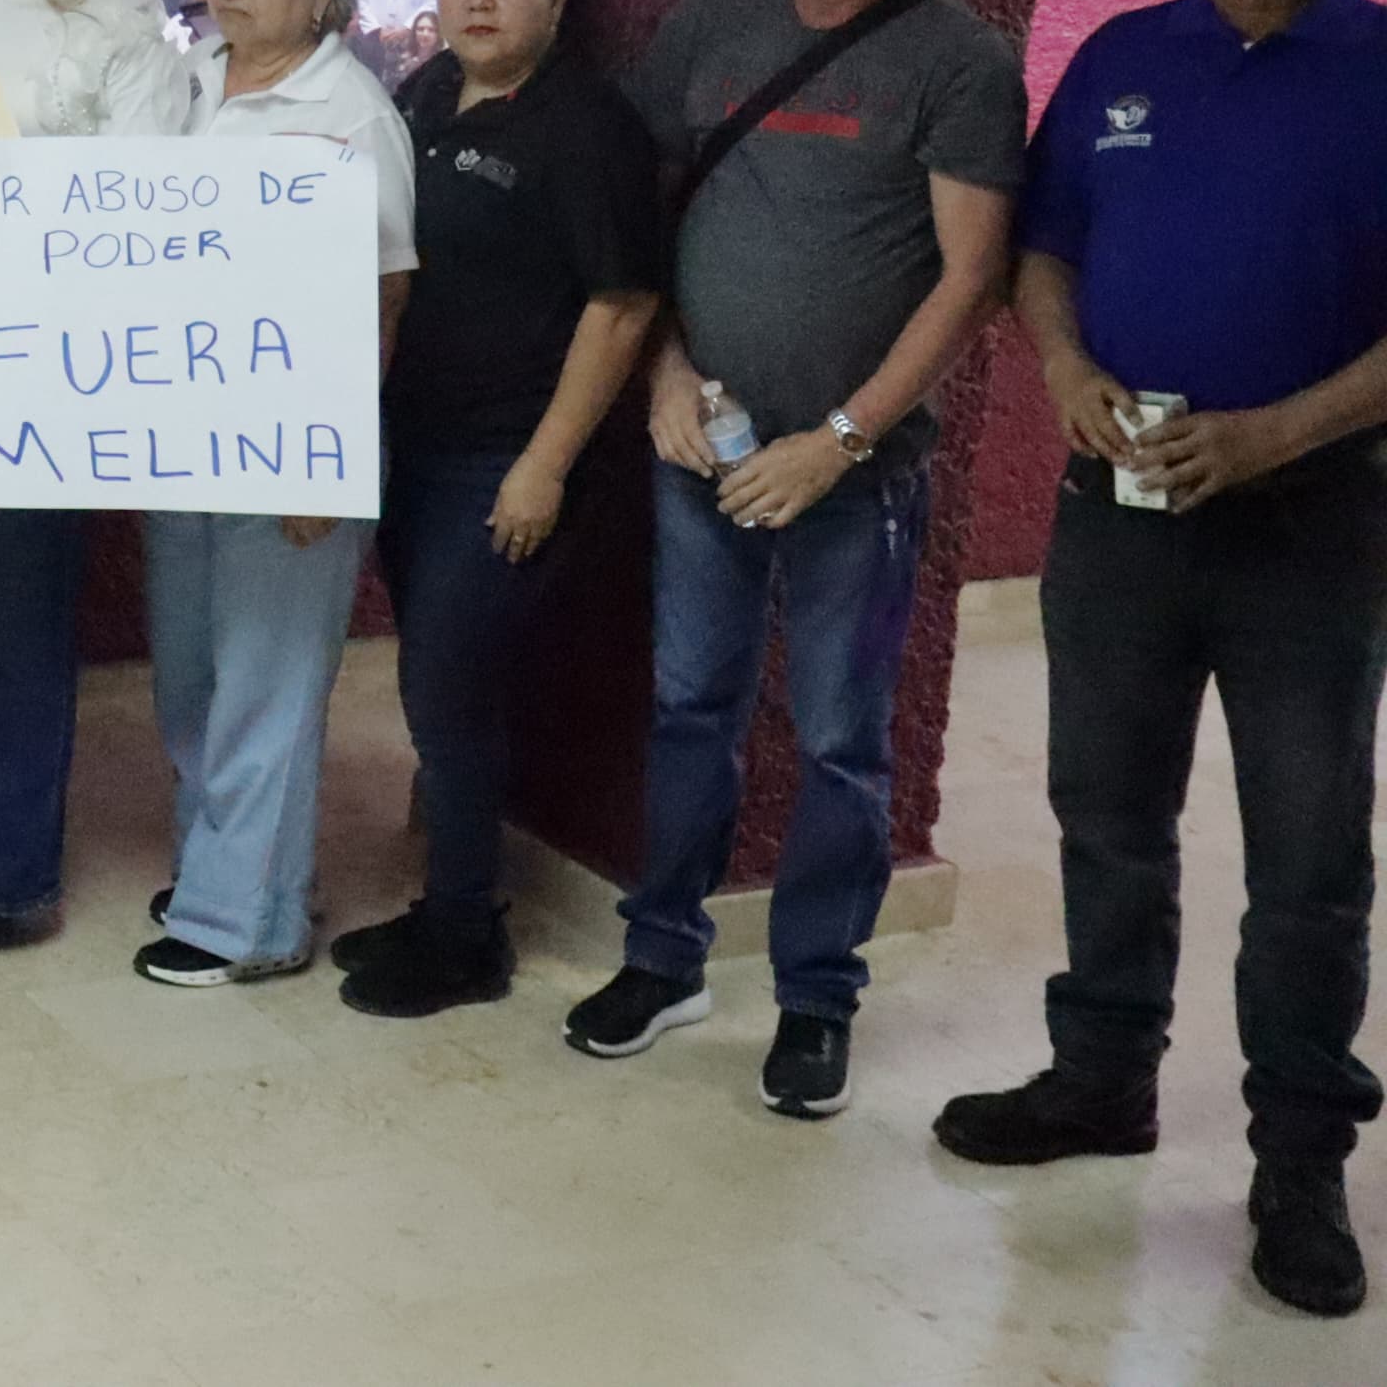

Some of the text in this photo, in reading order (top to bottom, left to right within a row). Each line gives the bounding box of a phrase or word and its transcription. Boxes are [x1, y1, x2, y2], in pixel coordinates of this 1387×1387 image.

[63, 170, 220, 213] ABUSO
[260, 171, 327, 204] DE
[43, 230, 231, 274] PODER
